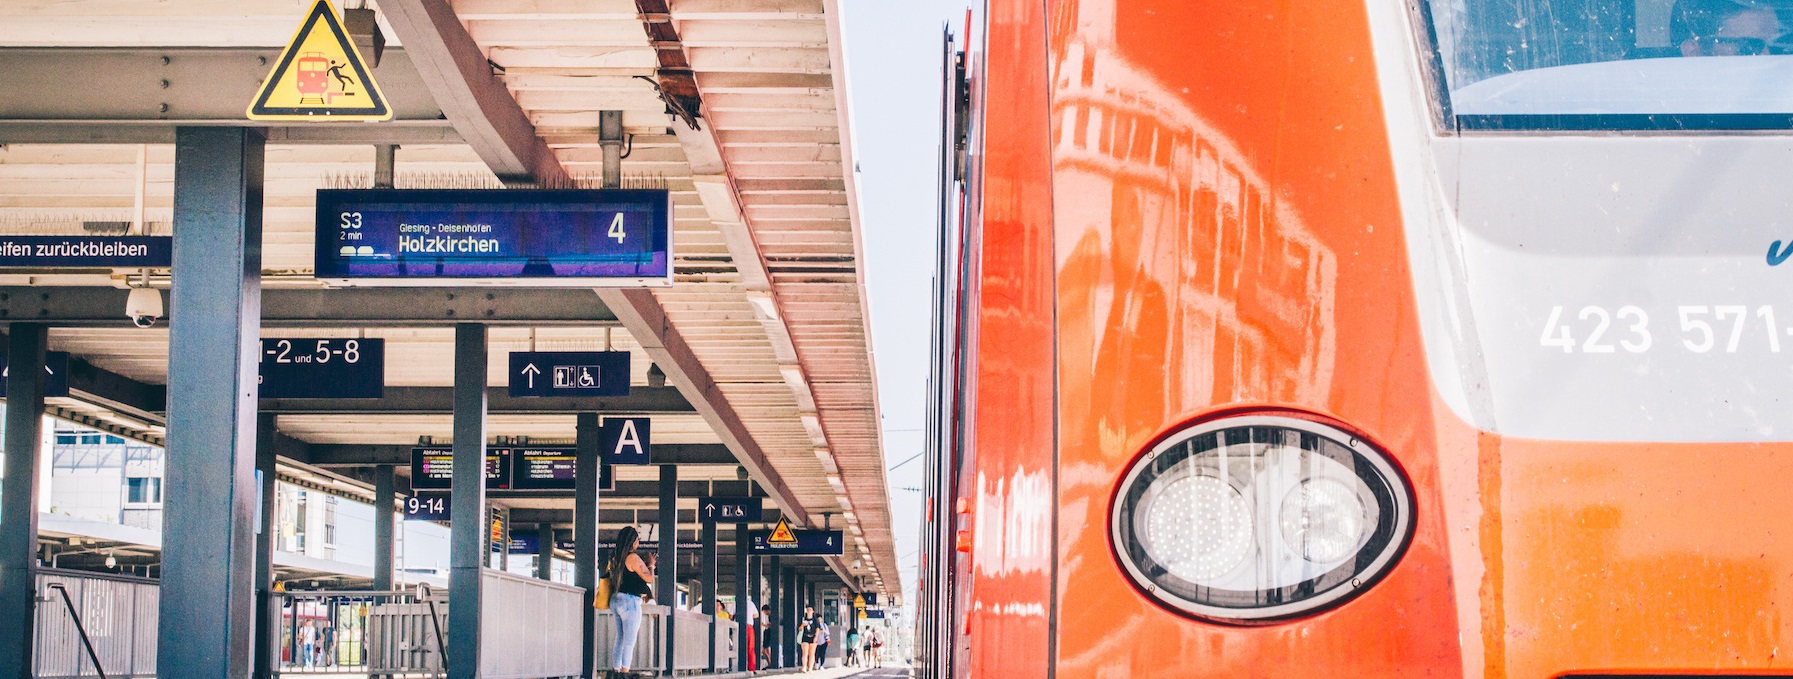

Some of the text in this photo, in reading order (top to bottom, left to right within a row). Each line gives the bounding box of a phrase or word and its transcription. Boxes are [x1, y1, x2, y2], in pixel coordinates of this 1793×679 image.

[340, 212, 626, 244] S3 4
[340, 231, 363, 240] 2 min
[399, 223, 430, 235] Giesing
[438, 223, 492, 233] Deisenhofen
[36, 241, 148, 257] zurückbleiben
[398, 235, 499, 253] Holzkirchen
[1539, 304, 1653, 354] 423
[295, 354, 312, 363] und
[315, 339, 360, 364] 5-8
[614, 419, 644, 455] A
[407, 497, 445, 515] 9-14
[826, 536, 833, 547] 4
